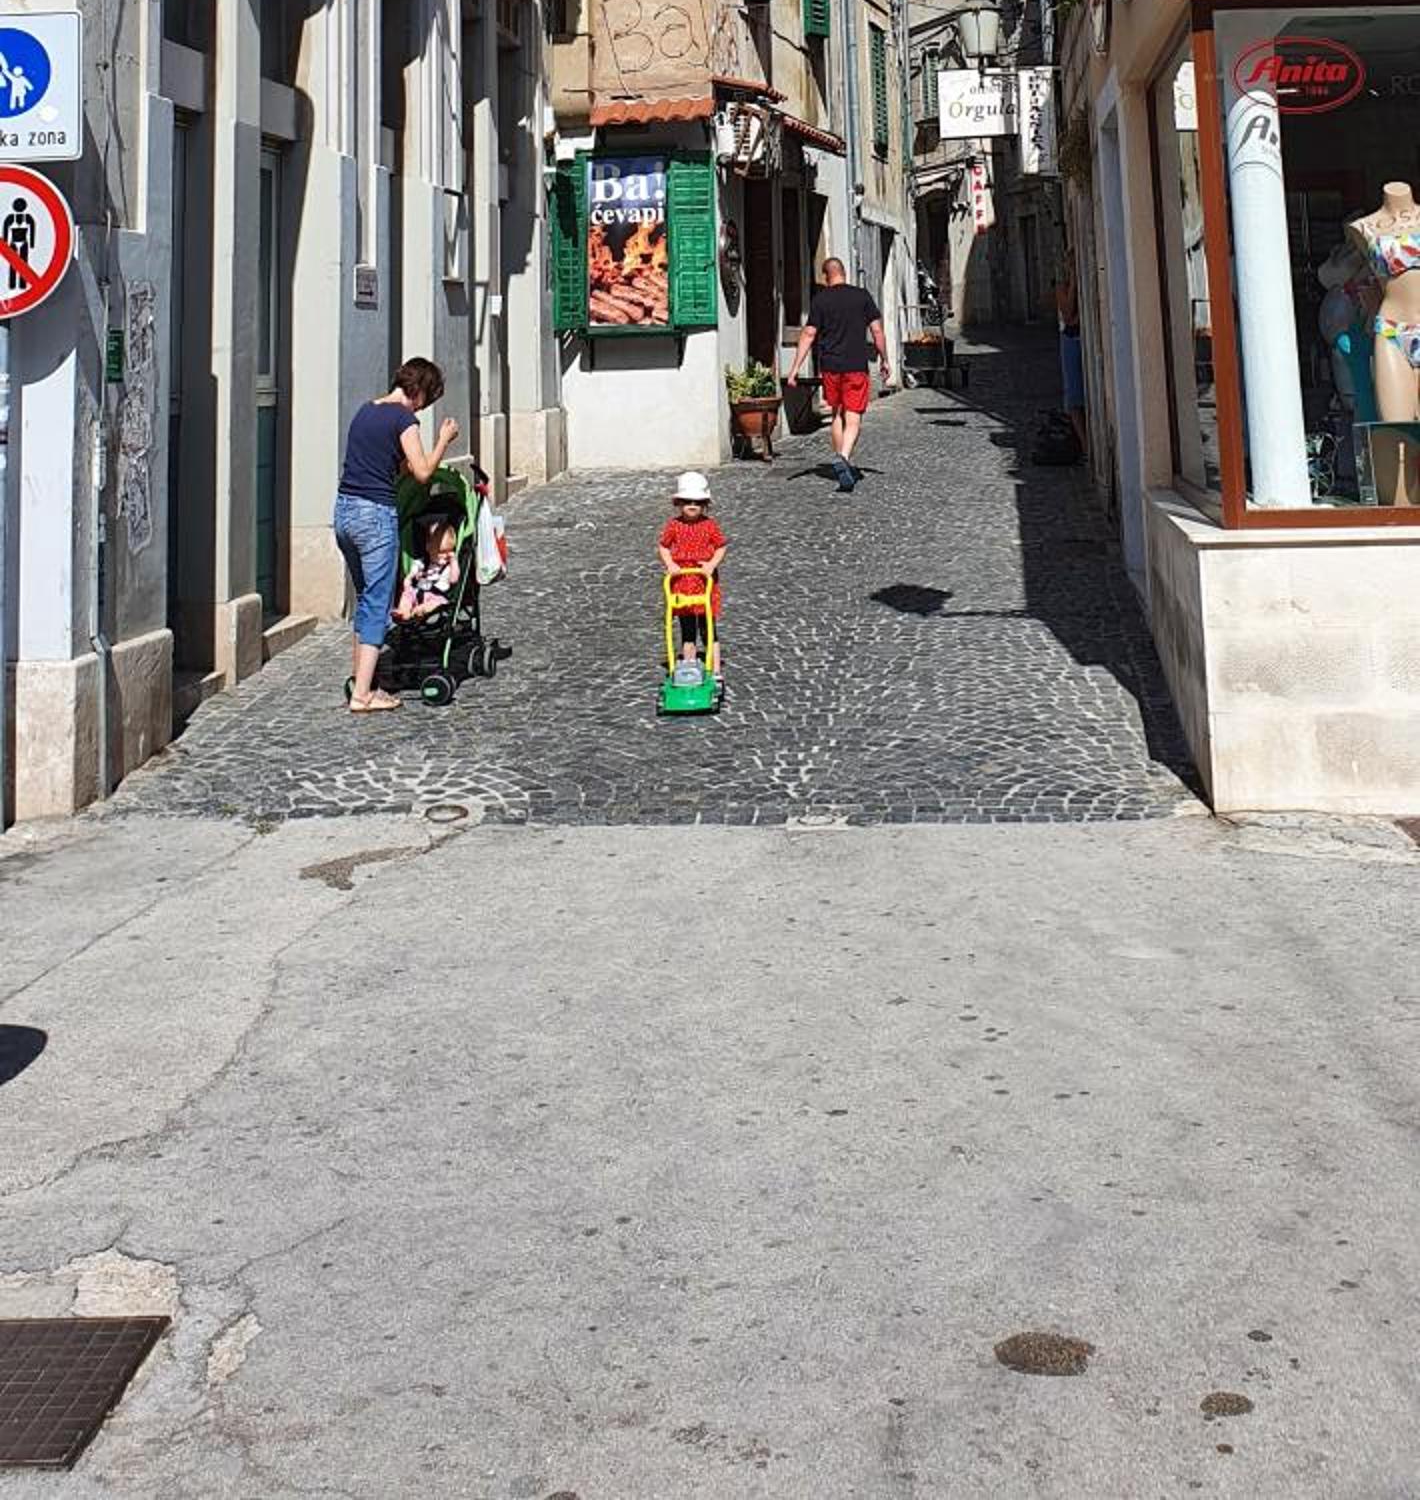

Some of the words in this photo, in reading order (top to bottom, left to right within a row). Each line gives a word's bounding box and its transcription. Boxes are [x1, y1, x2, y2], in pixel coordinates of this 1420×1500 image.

[1245, 55, 1348, 85] Anita
[28, 131, 66, 147] zona
[592, 161, 665, 202] Ba!
[591, 203, 665, 229] ćevapi
